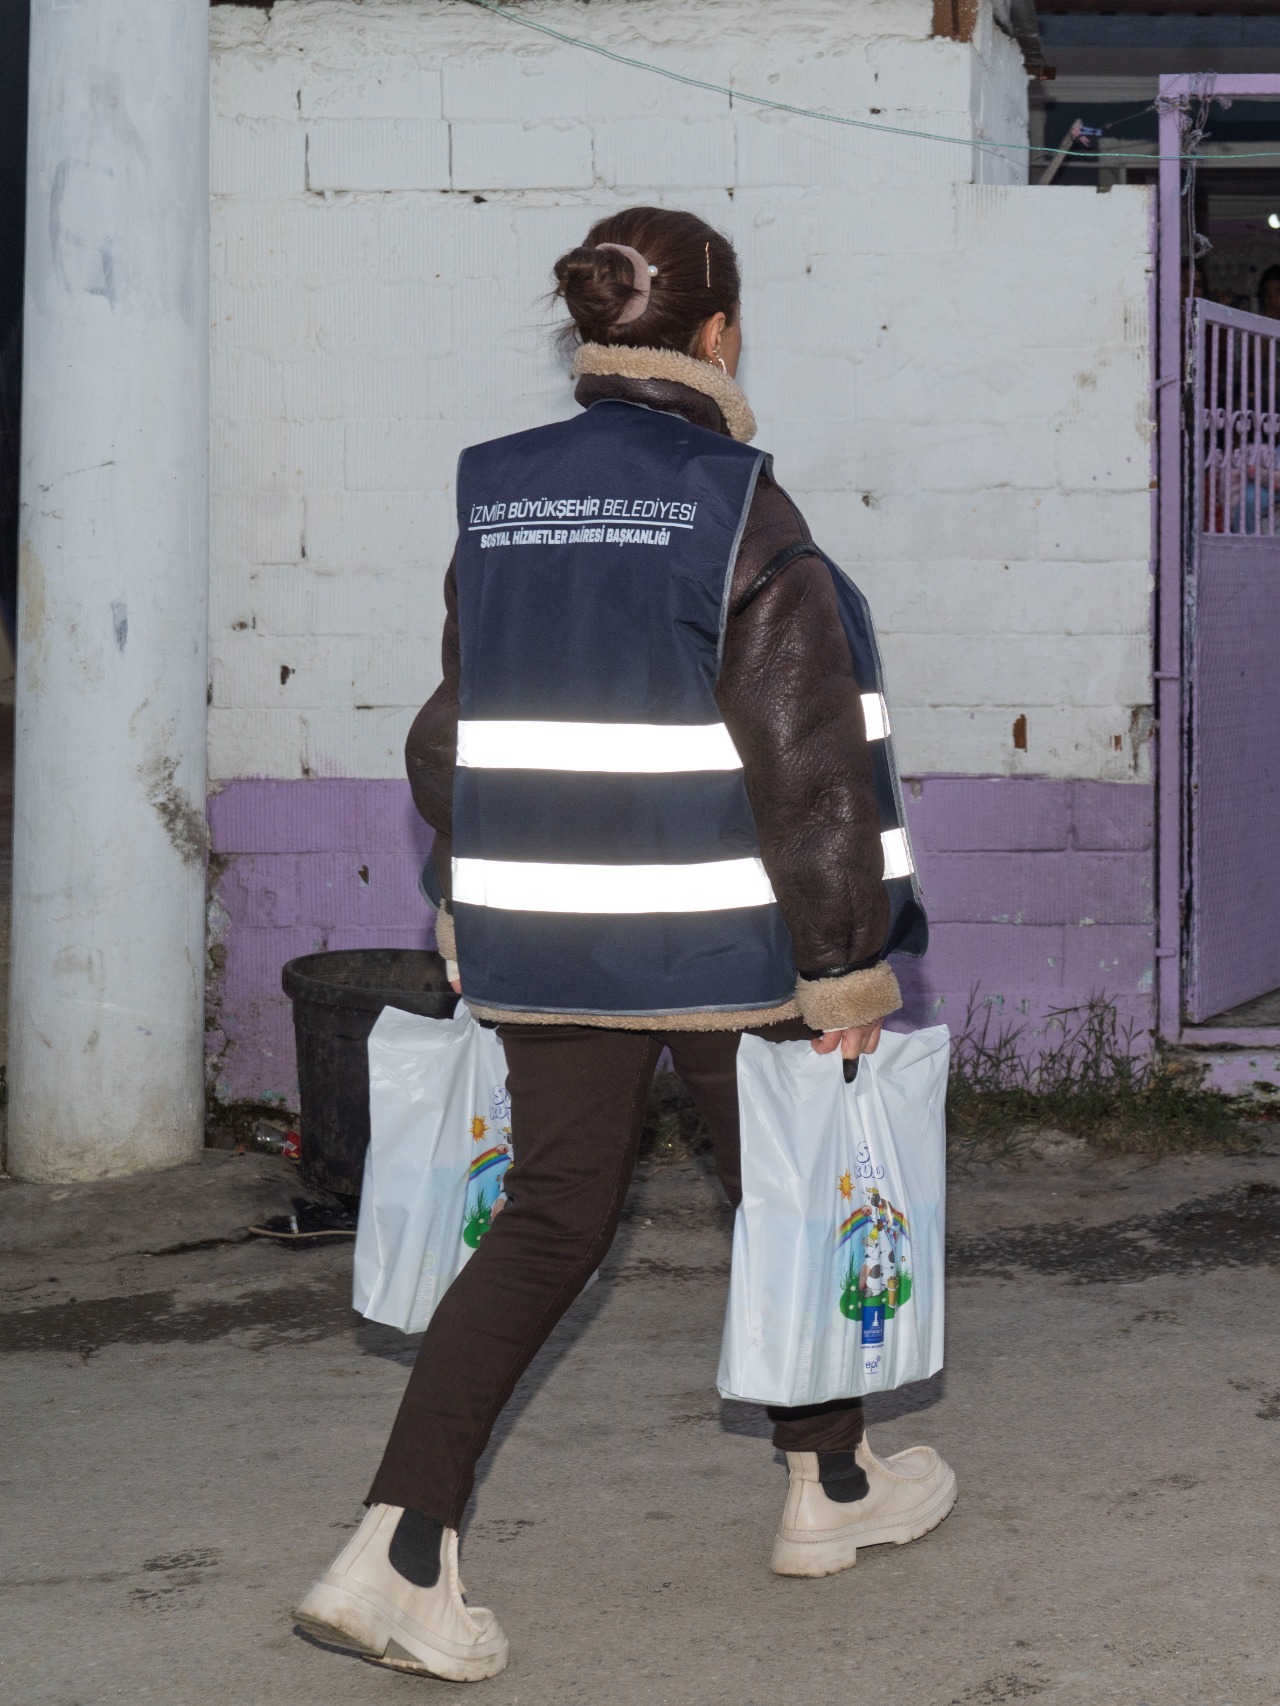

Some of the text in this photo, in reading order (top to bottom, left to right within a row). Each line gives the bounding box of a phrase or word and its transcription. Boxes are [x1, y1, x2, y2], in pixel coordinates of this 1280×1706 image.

[470, 496, 697, 523] İZMİR BÜYÜKŞEHİR BELEDİYESİ
[480, 525, 670, 548] SOSYAL HİZMETLER DAİRESİ BAŞKANLIĞI
